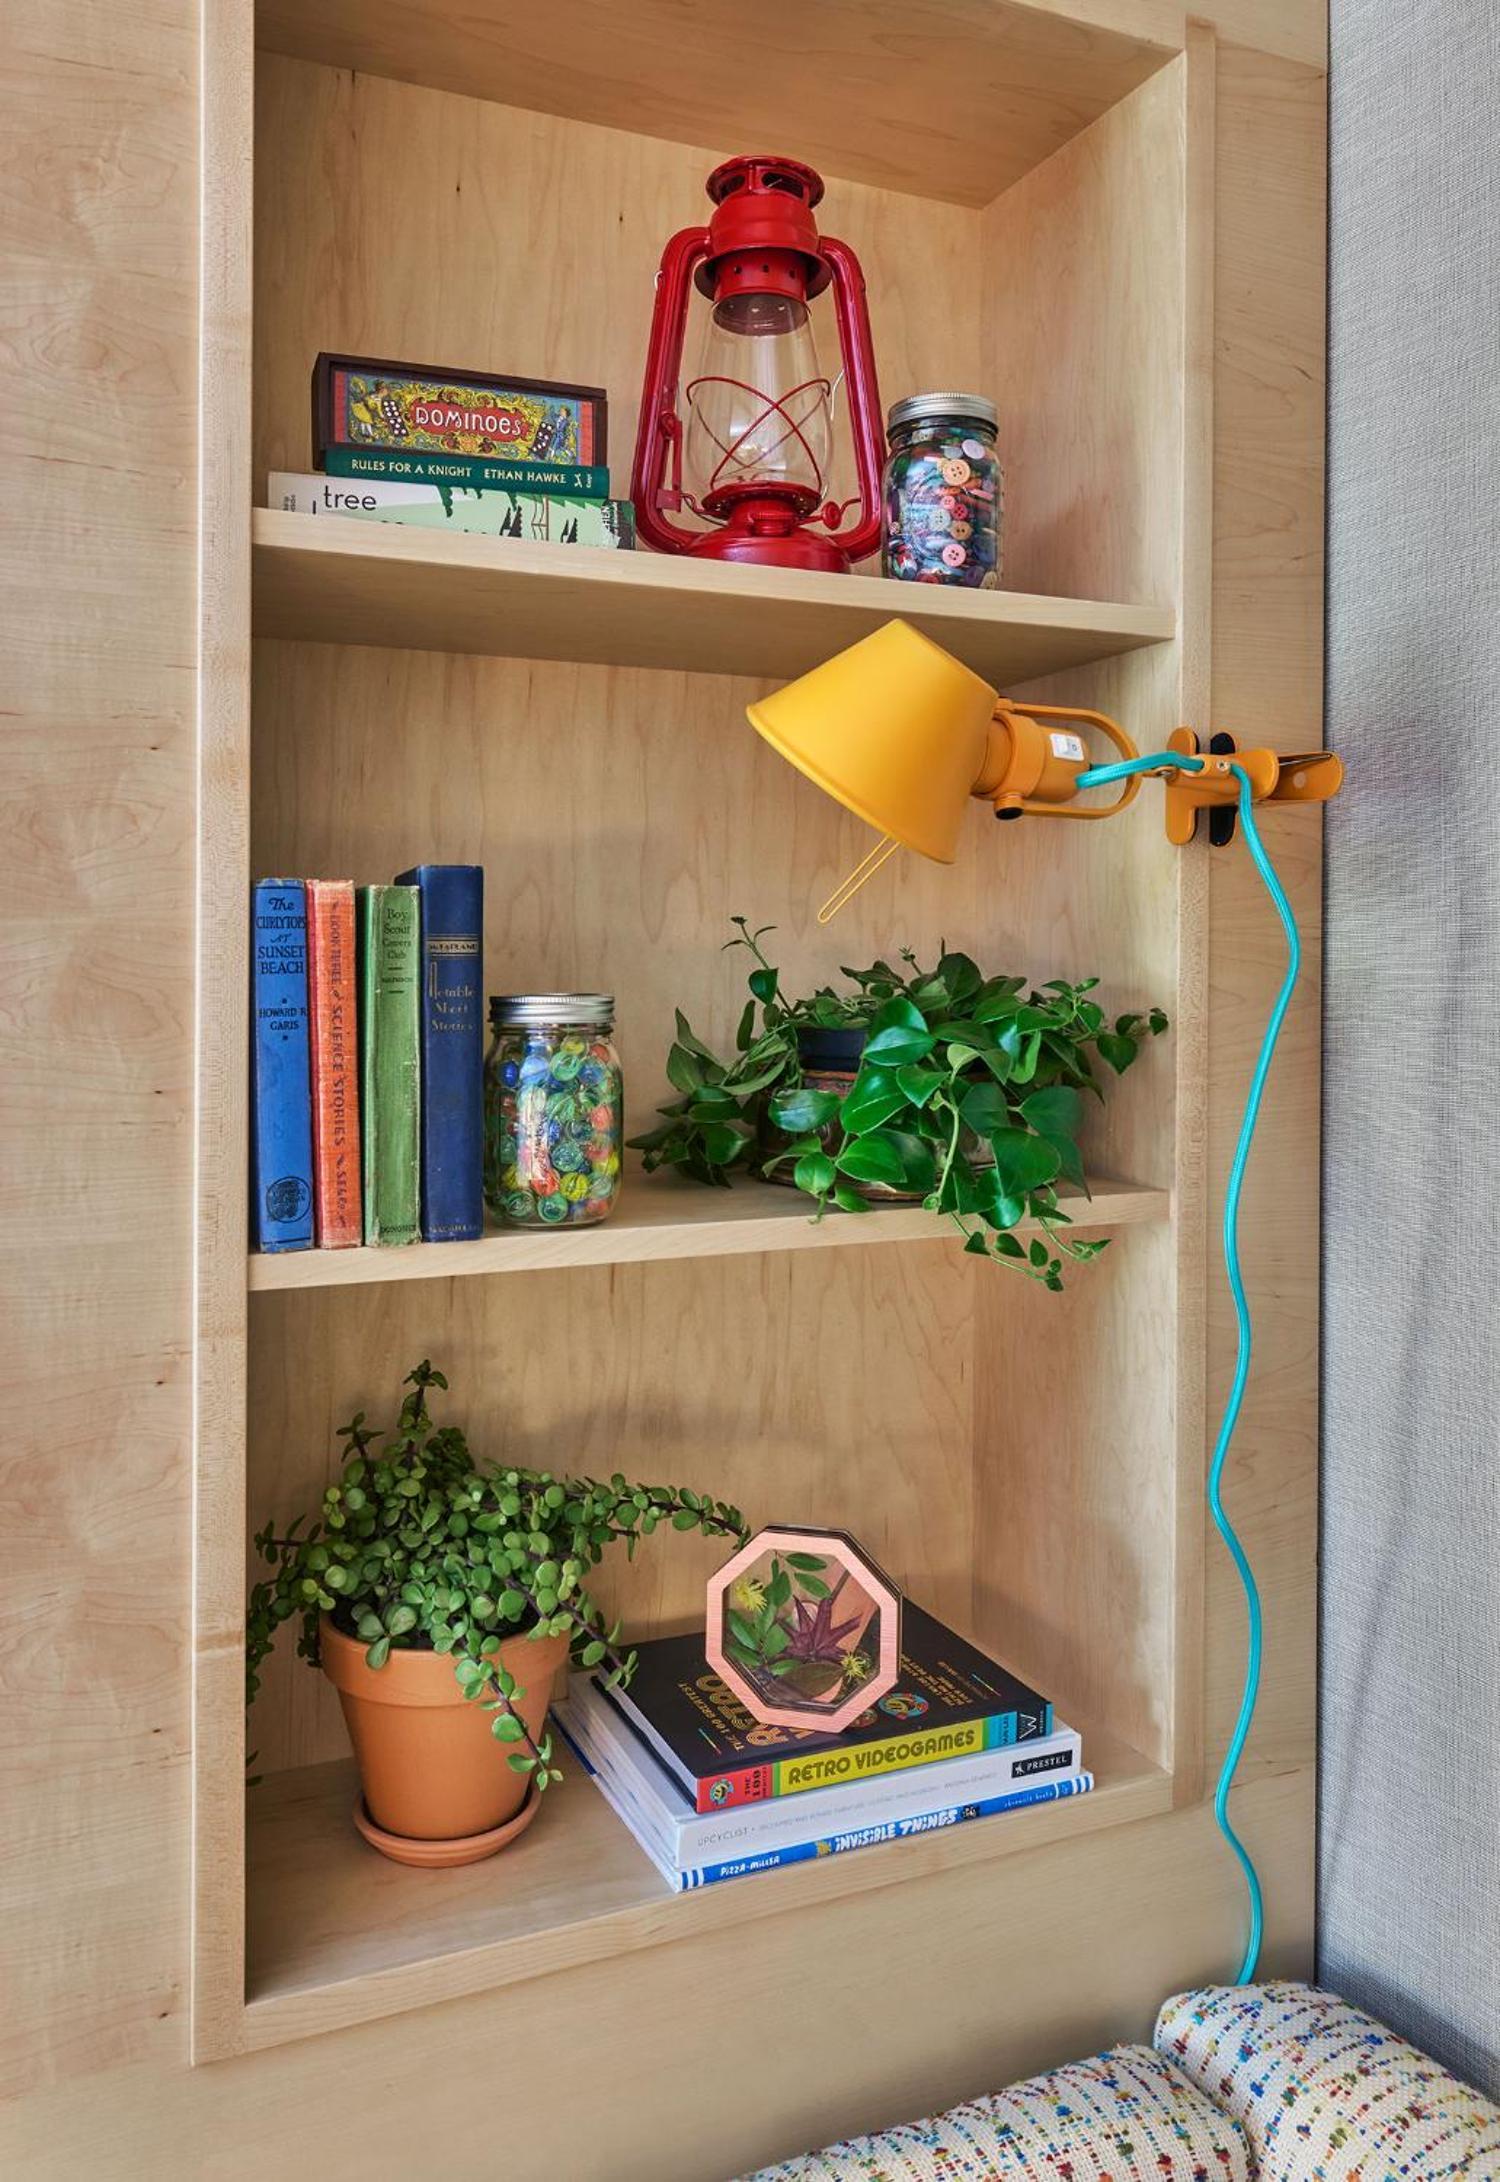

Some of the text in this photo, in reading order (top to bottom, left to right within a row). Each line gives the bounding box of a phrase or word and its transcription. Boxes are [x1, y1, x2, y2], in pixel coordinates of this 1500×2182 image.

[351, 459, 567, 484] RULES FOR A KNIGHT ETHAN HAWKE
[323, 485, 377, 511] tree
[268, 897, 295, 911] The
[387, 908, 408, 921] Boy
[258, 945, 305, 958] SUNSET
[261, 961, 304, 975] BEACH
[259, 1007, 298, 1018] HOWARD
[270, 1020, 300, 1031] GARIS
[332, 1005, 345, 1072] SCIENCE
[333, 1077, 346, 1146] STORIES
[788, 1757, 850, 1785] RETRO
[854, 1729, 976, 1770] VIDEOGAMES
[1026, 1755, 1067, 1771] PRESTEL
[752, 1769, 763, 1798] 100
[697, 1826, 749, 1847] UPCYCLIST
[835, 1823, 897, 1852] INVISIBLE
[899, 1809, 958, 1836] THINGS
